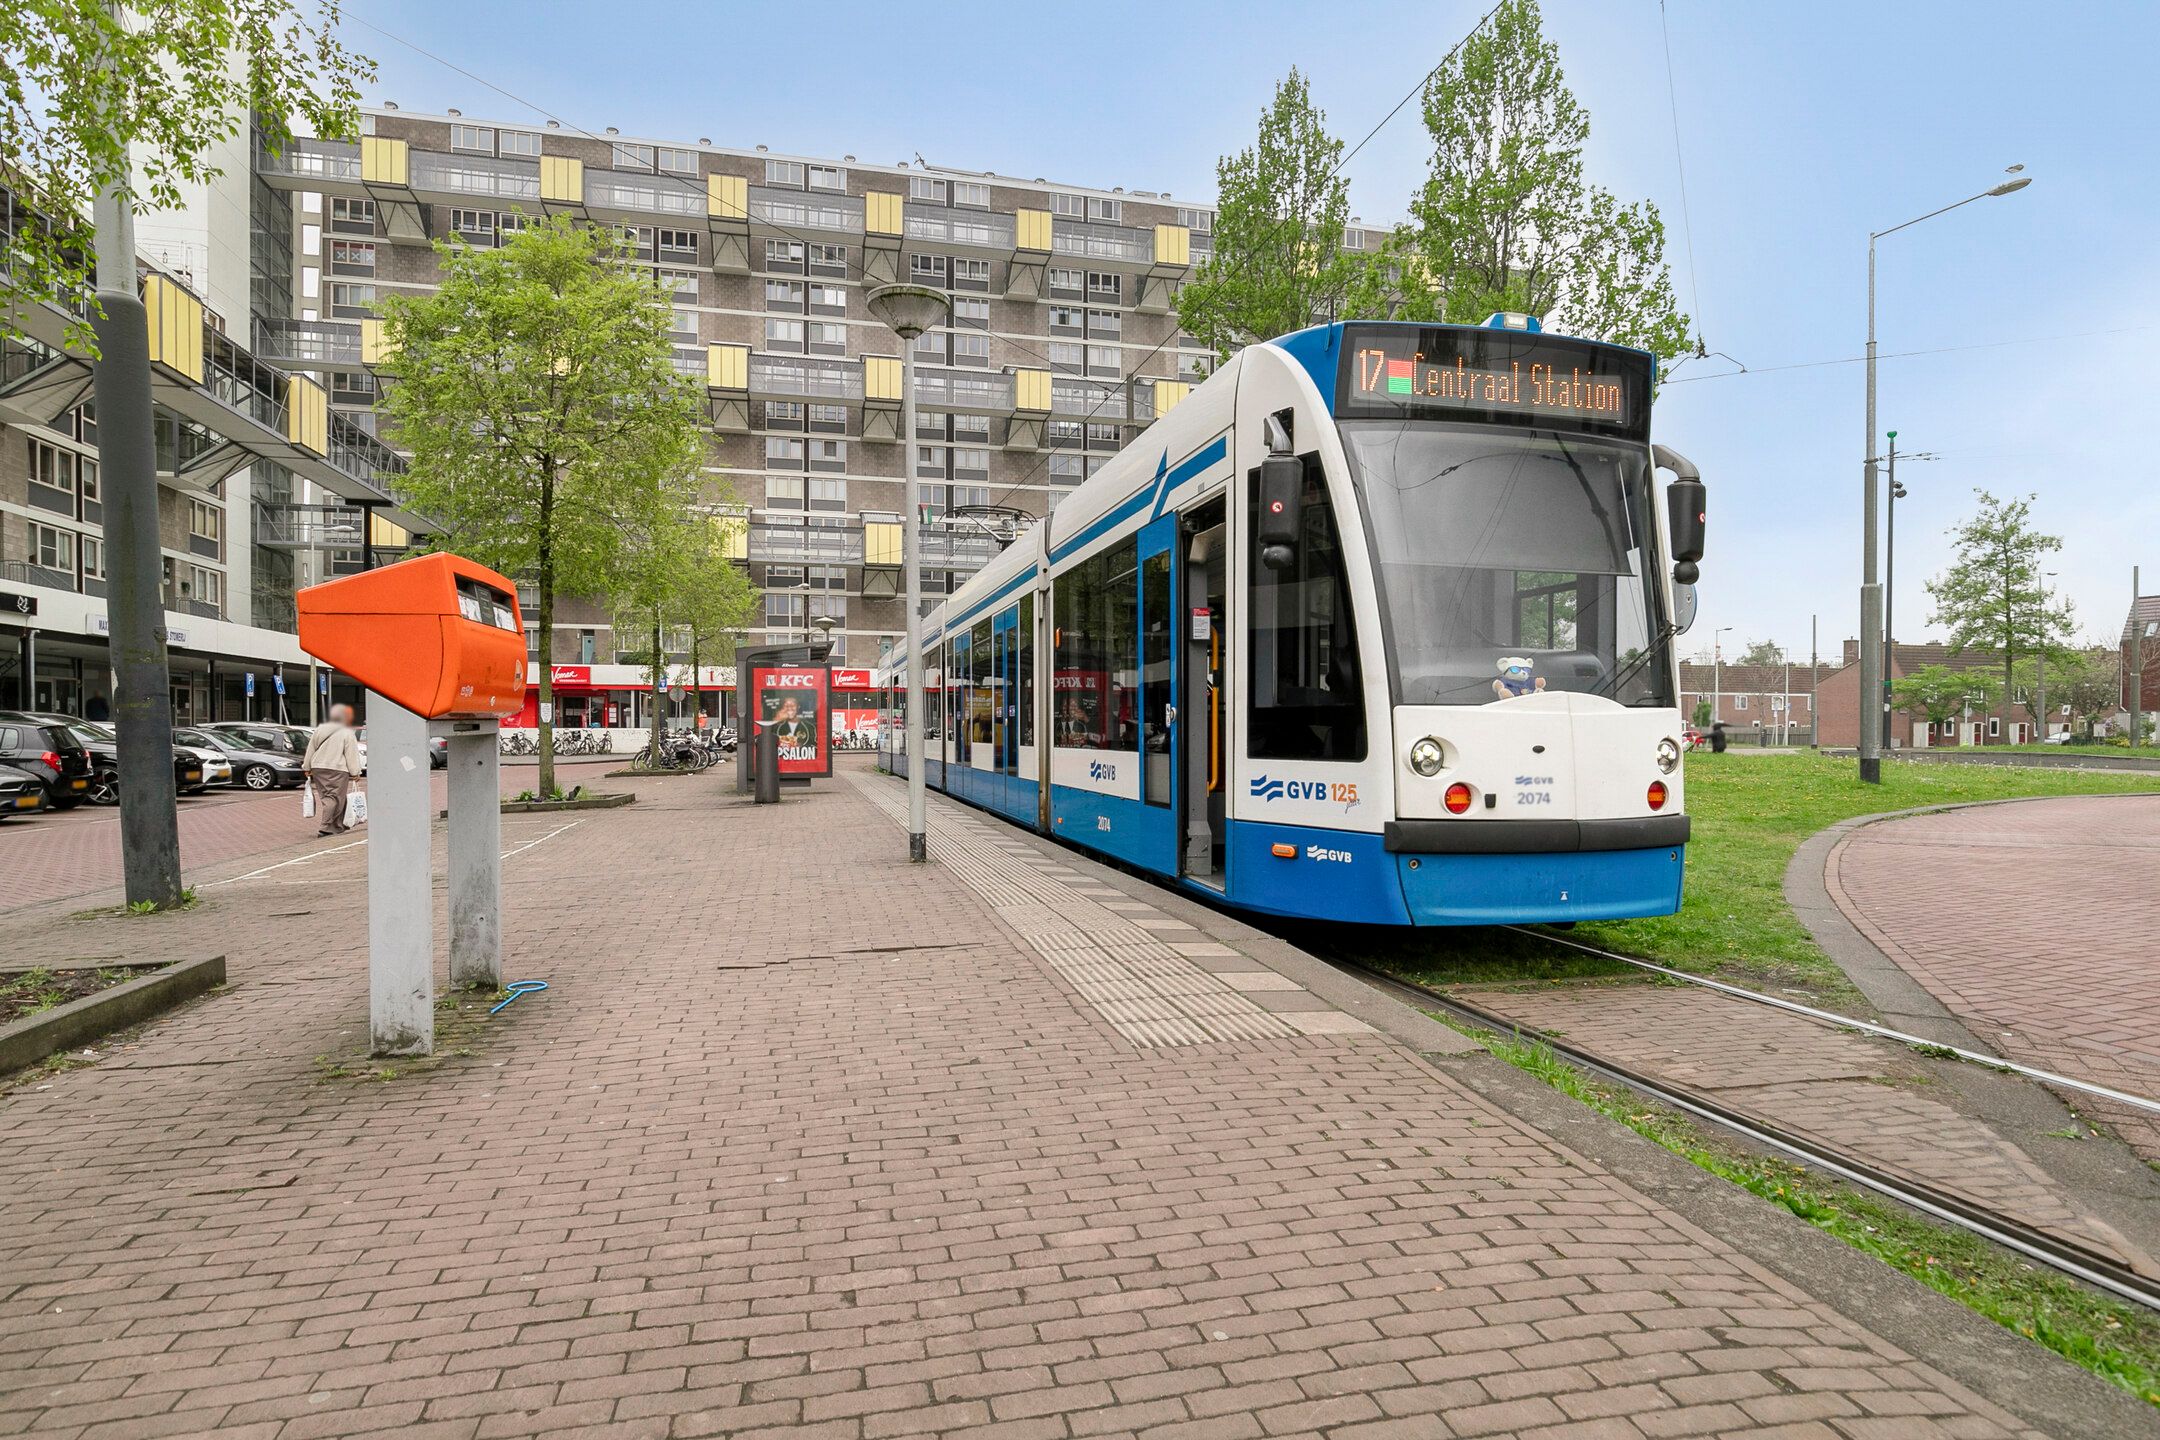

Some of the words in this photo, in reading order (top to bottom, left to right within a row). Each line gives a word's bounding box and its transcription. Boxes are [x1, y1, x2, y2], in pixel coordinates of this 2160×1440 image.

[1359, 349, 1385, 391] 17
[1413, 352, 1520, 403] Centraal
[1531, 363, 1619, 411] Station
[779, 674, 814, 687] KFC
[777, 746, 816, 760] PSALON
[1102, 763, 1116, 781] GVB
[1534, 776, 1554, 785] GVB
[1287, 780, 1327, 801] GVB
[1331, 783, 1357, 802] 125
[1517, 792, 1551, 805] 2074
[1098, 815, 1111, 832] 2074
[1328, 849, 1352, 863] GVB
